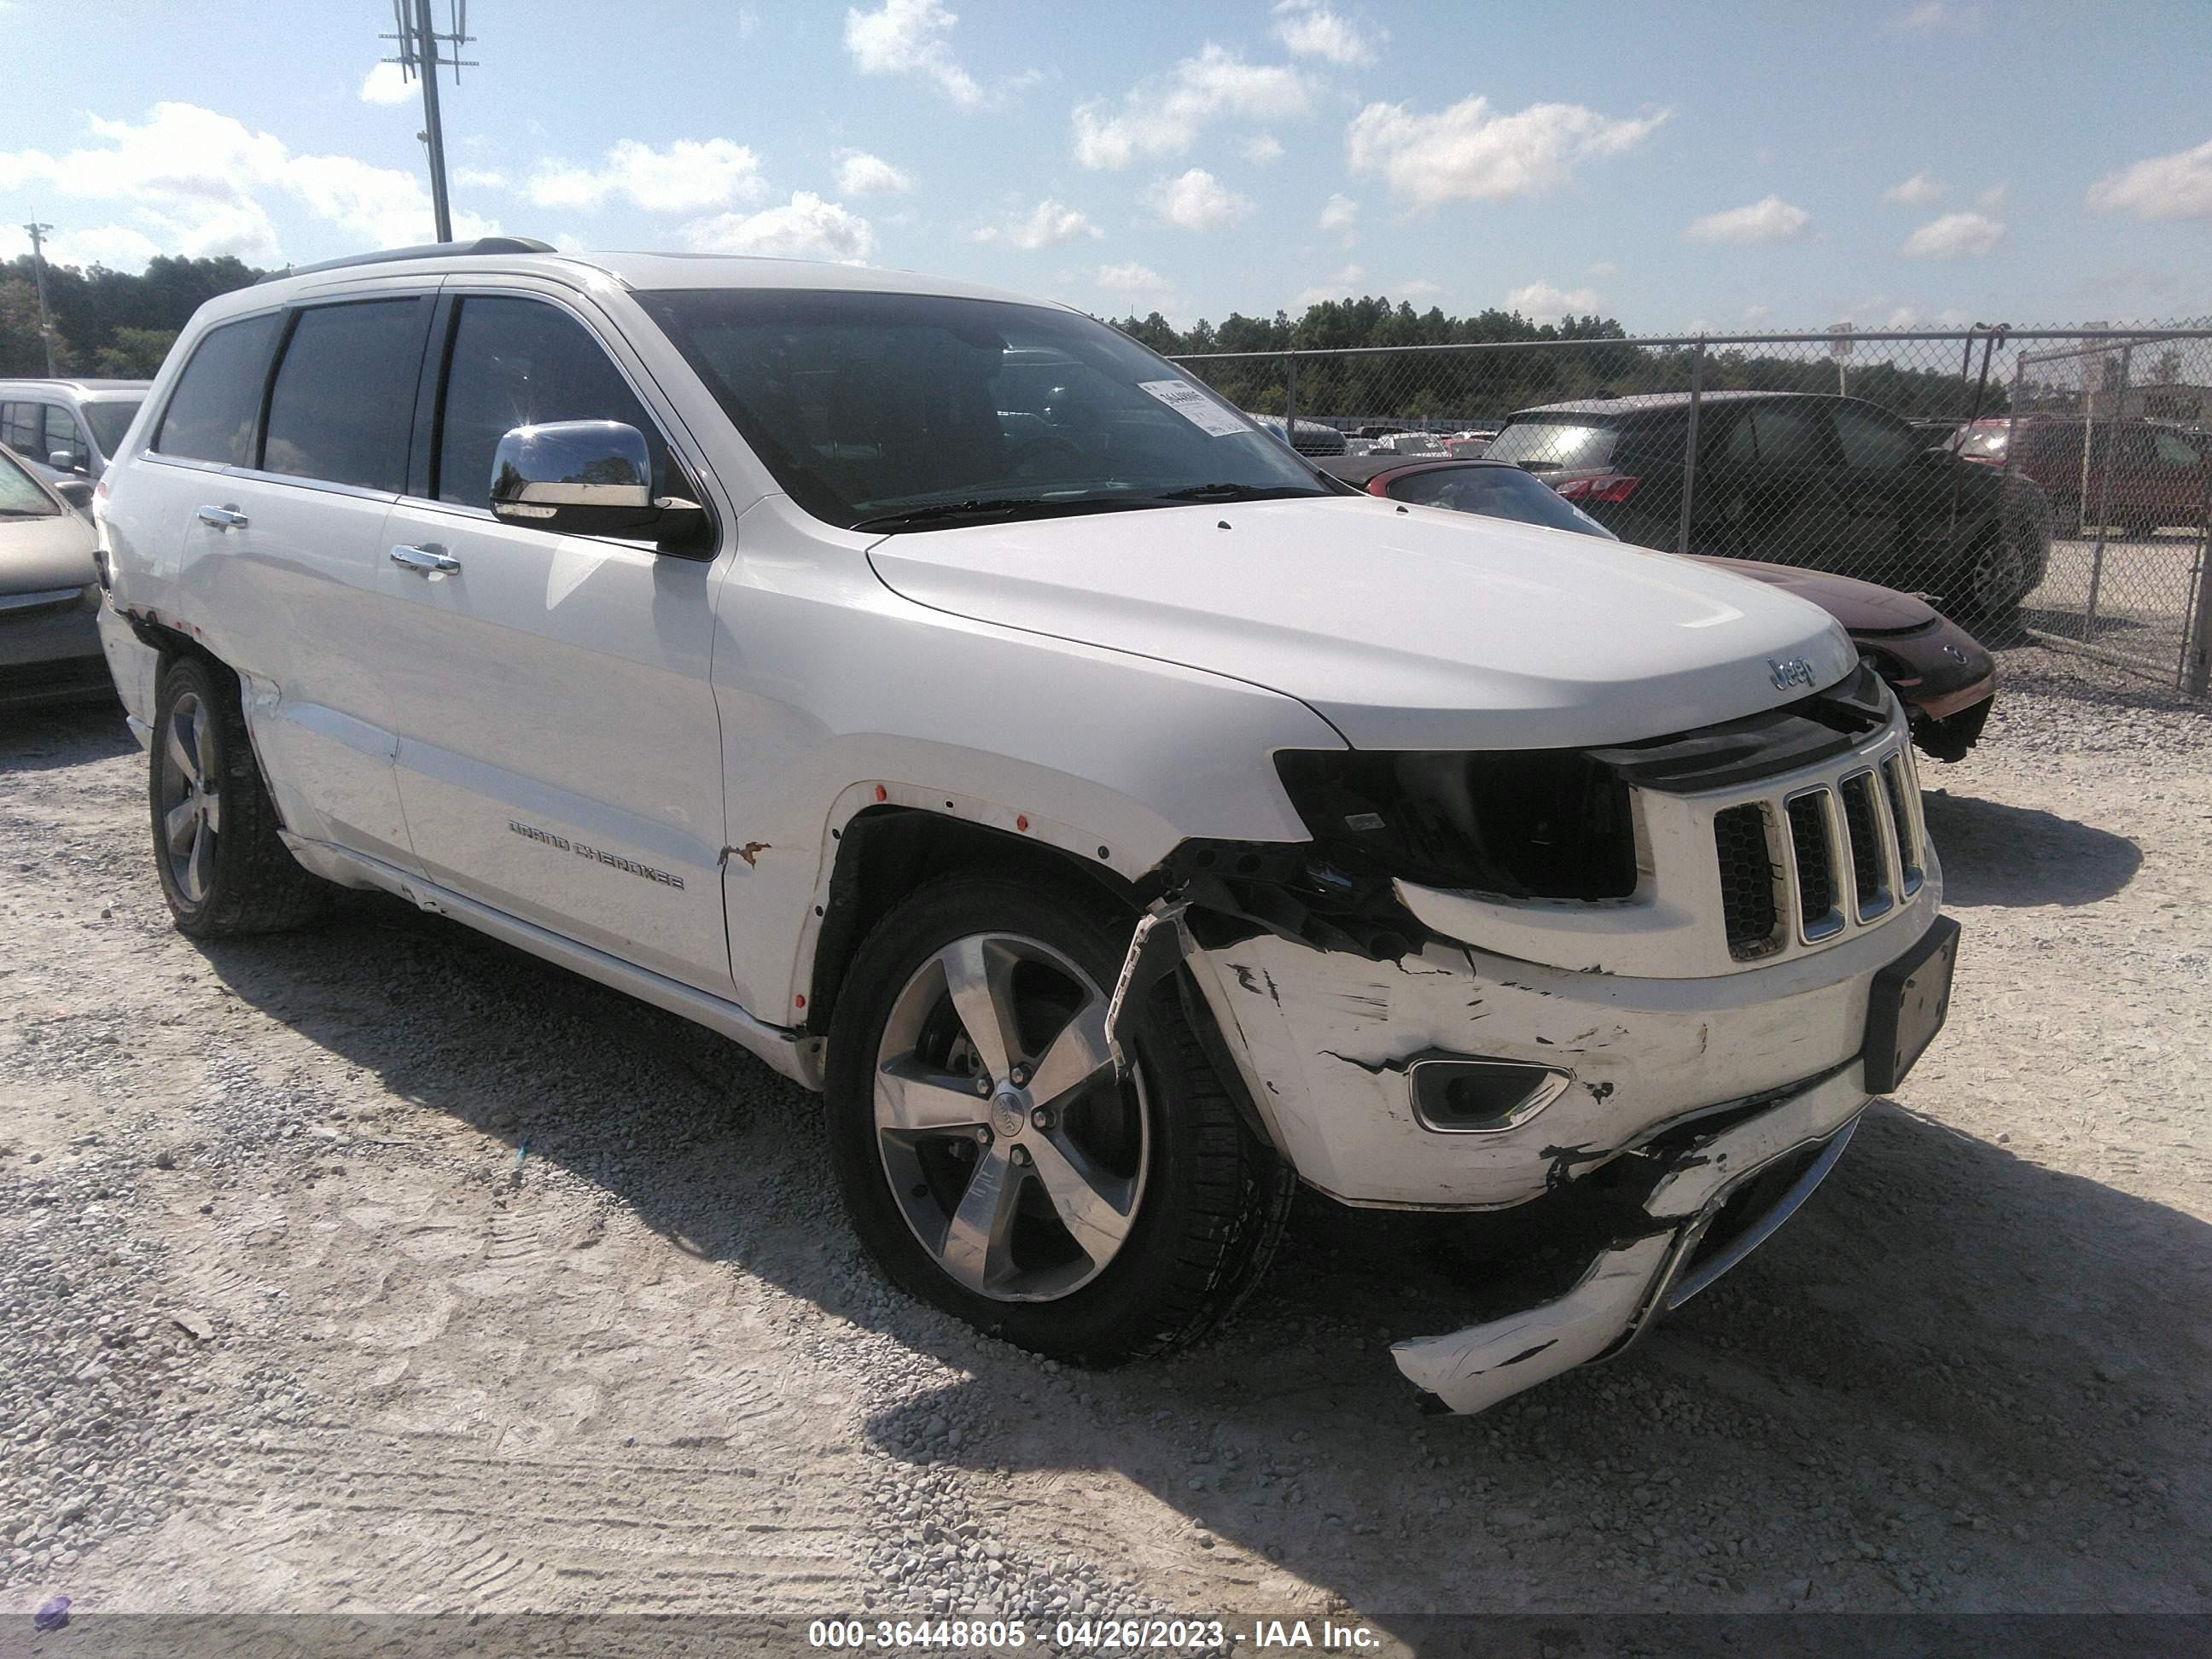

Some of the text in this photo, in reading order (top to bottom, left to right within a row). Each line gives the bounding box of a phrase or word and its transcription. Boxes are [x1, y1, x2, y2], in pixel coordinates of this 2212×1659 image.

[1767, 656, 1816, 690] Jeep
[508, 819, 685, 891] GRAND CHEROKEE
